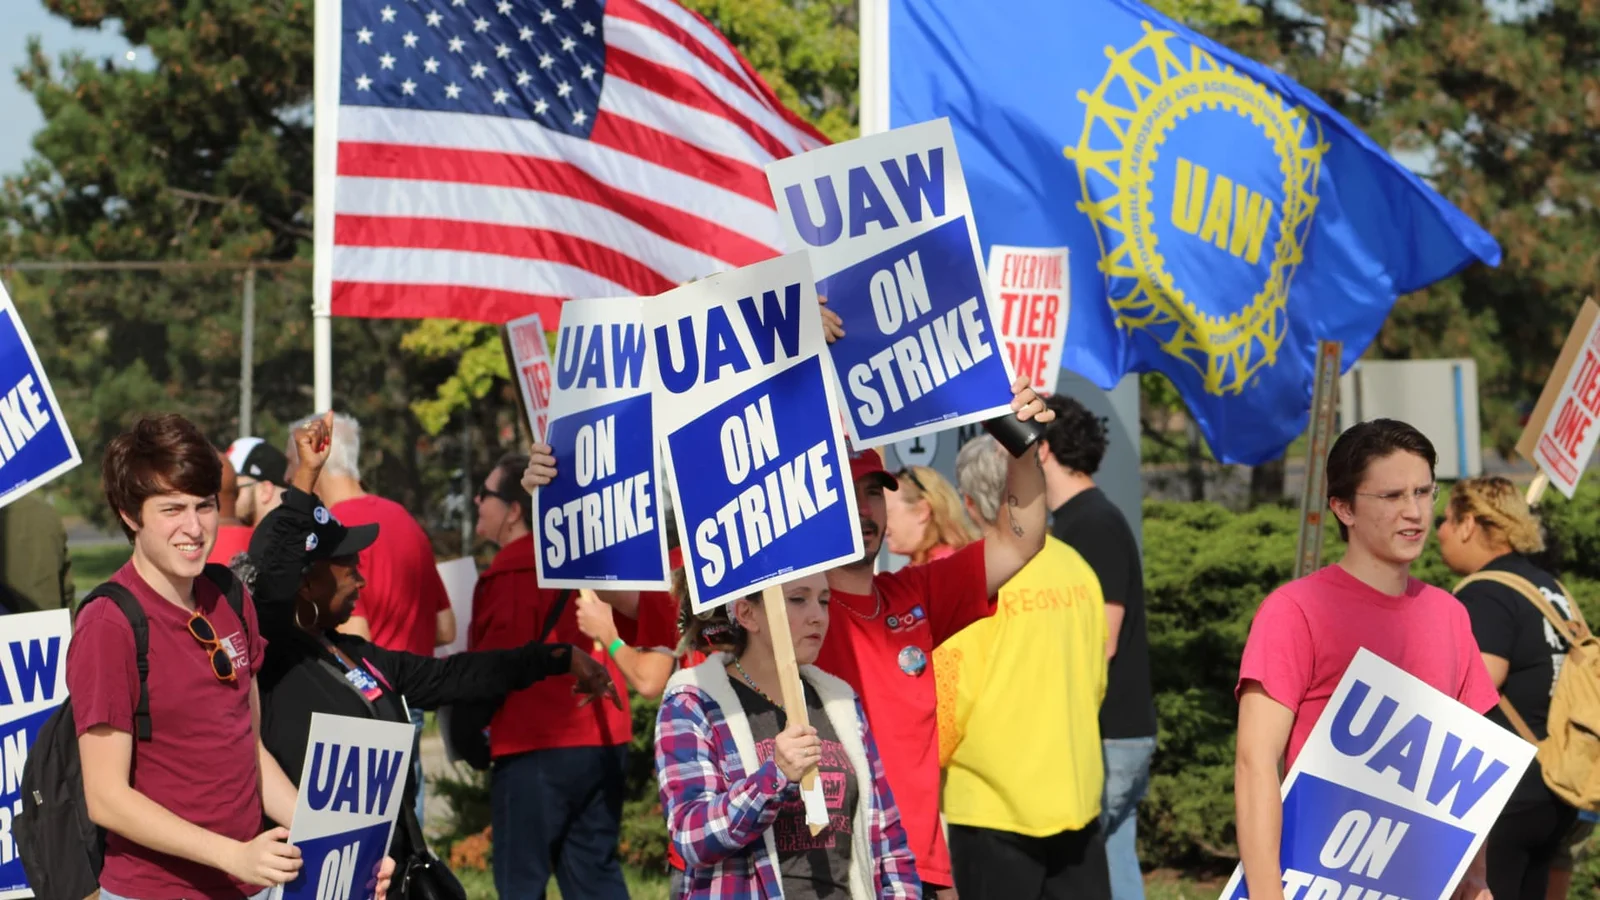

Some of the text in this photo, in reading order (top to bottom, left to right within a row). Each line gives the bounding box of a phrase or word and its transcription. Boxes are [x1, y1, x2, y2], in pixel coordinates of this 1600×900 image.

[784, 147, 946, 247] UAW
[1171, 156, 1273, 265] UAW
[869, 251, 932, 336] ON
[1000, 293, 1059, 338] TIER
[1001, 253, 1063, 290] EVERYONE
[557, 323, 647, 390] UAW
[654, 282, 801, 394] UAW
[847, 296, 993, 427] STRIKE
[0, 373, 51, 464] IKE
[575, 414, 616, 487] ON
[720, 394, 780, 485] ON
[1553, 396, 1592, 460] ONE
[544, 470, 654, 568] STRIKE
[695, 440, 838, 588] STRIKE
[307, 742, 404, 816] UAW
[1330, 678, 1511, 820] UAW
[316, 840, 361, 900] ON
[1319, 809, 1410, 880] ON
